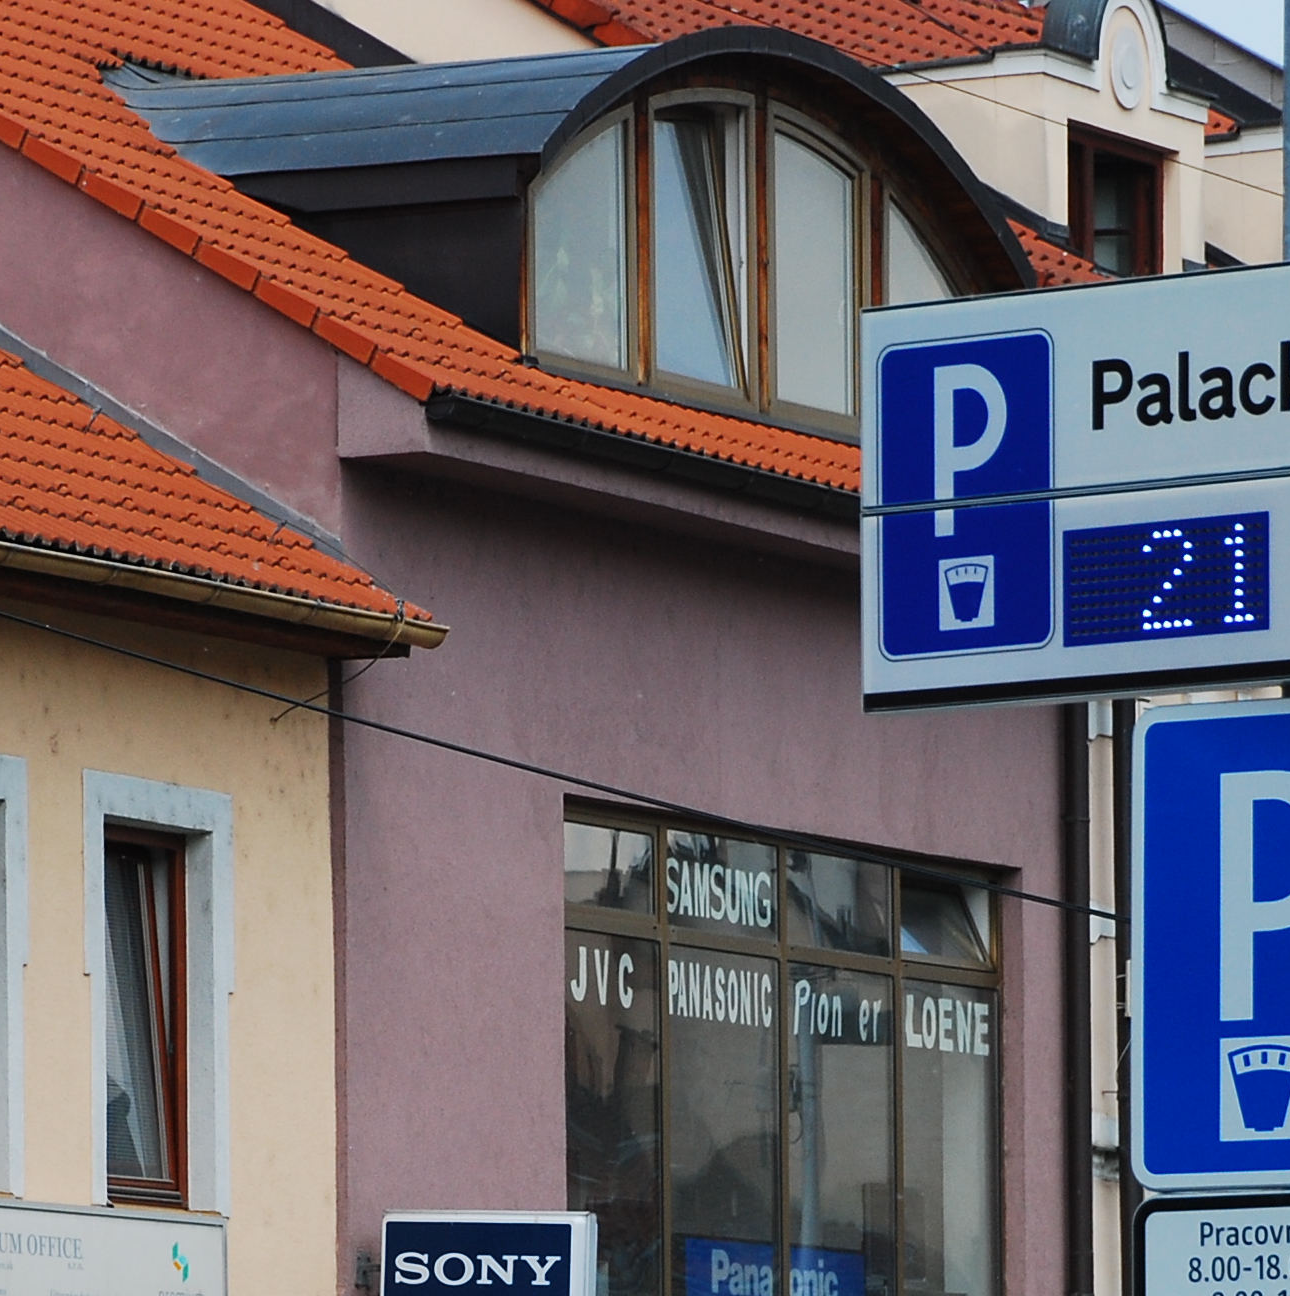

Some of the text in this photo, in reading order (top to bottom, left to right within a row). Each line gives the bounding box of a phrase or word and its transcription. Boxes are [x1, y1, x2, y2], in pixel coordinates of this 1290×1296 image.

[932, 363, 1007, 538] P
[1143, 522, 1255, 630] 21
[666, 856, 772, 928] SAMSUNG
[668, 958, 773, 1029] PANASONIC
[395, 1251, 562, 1287] SONY
